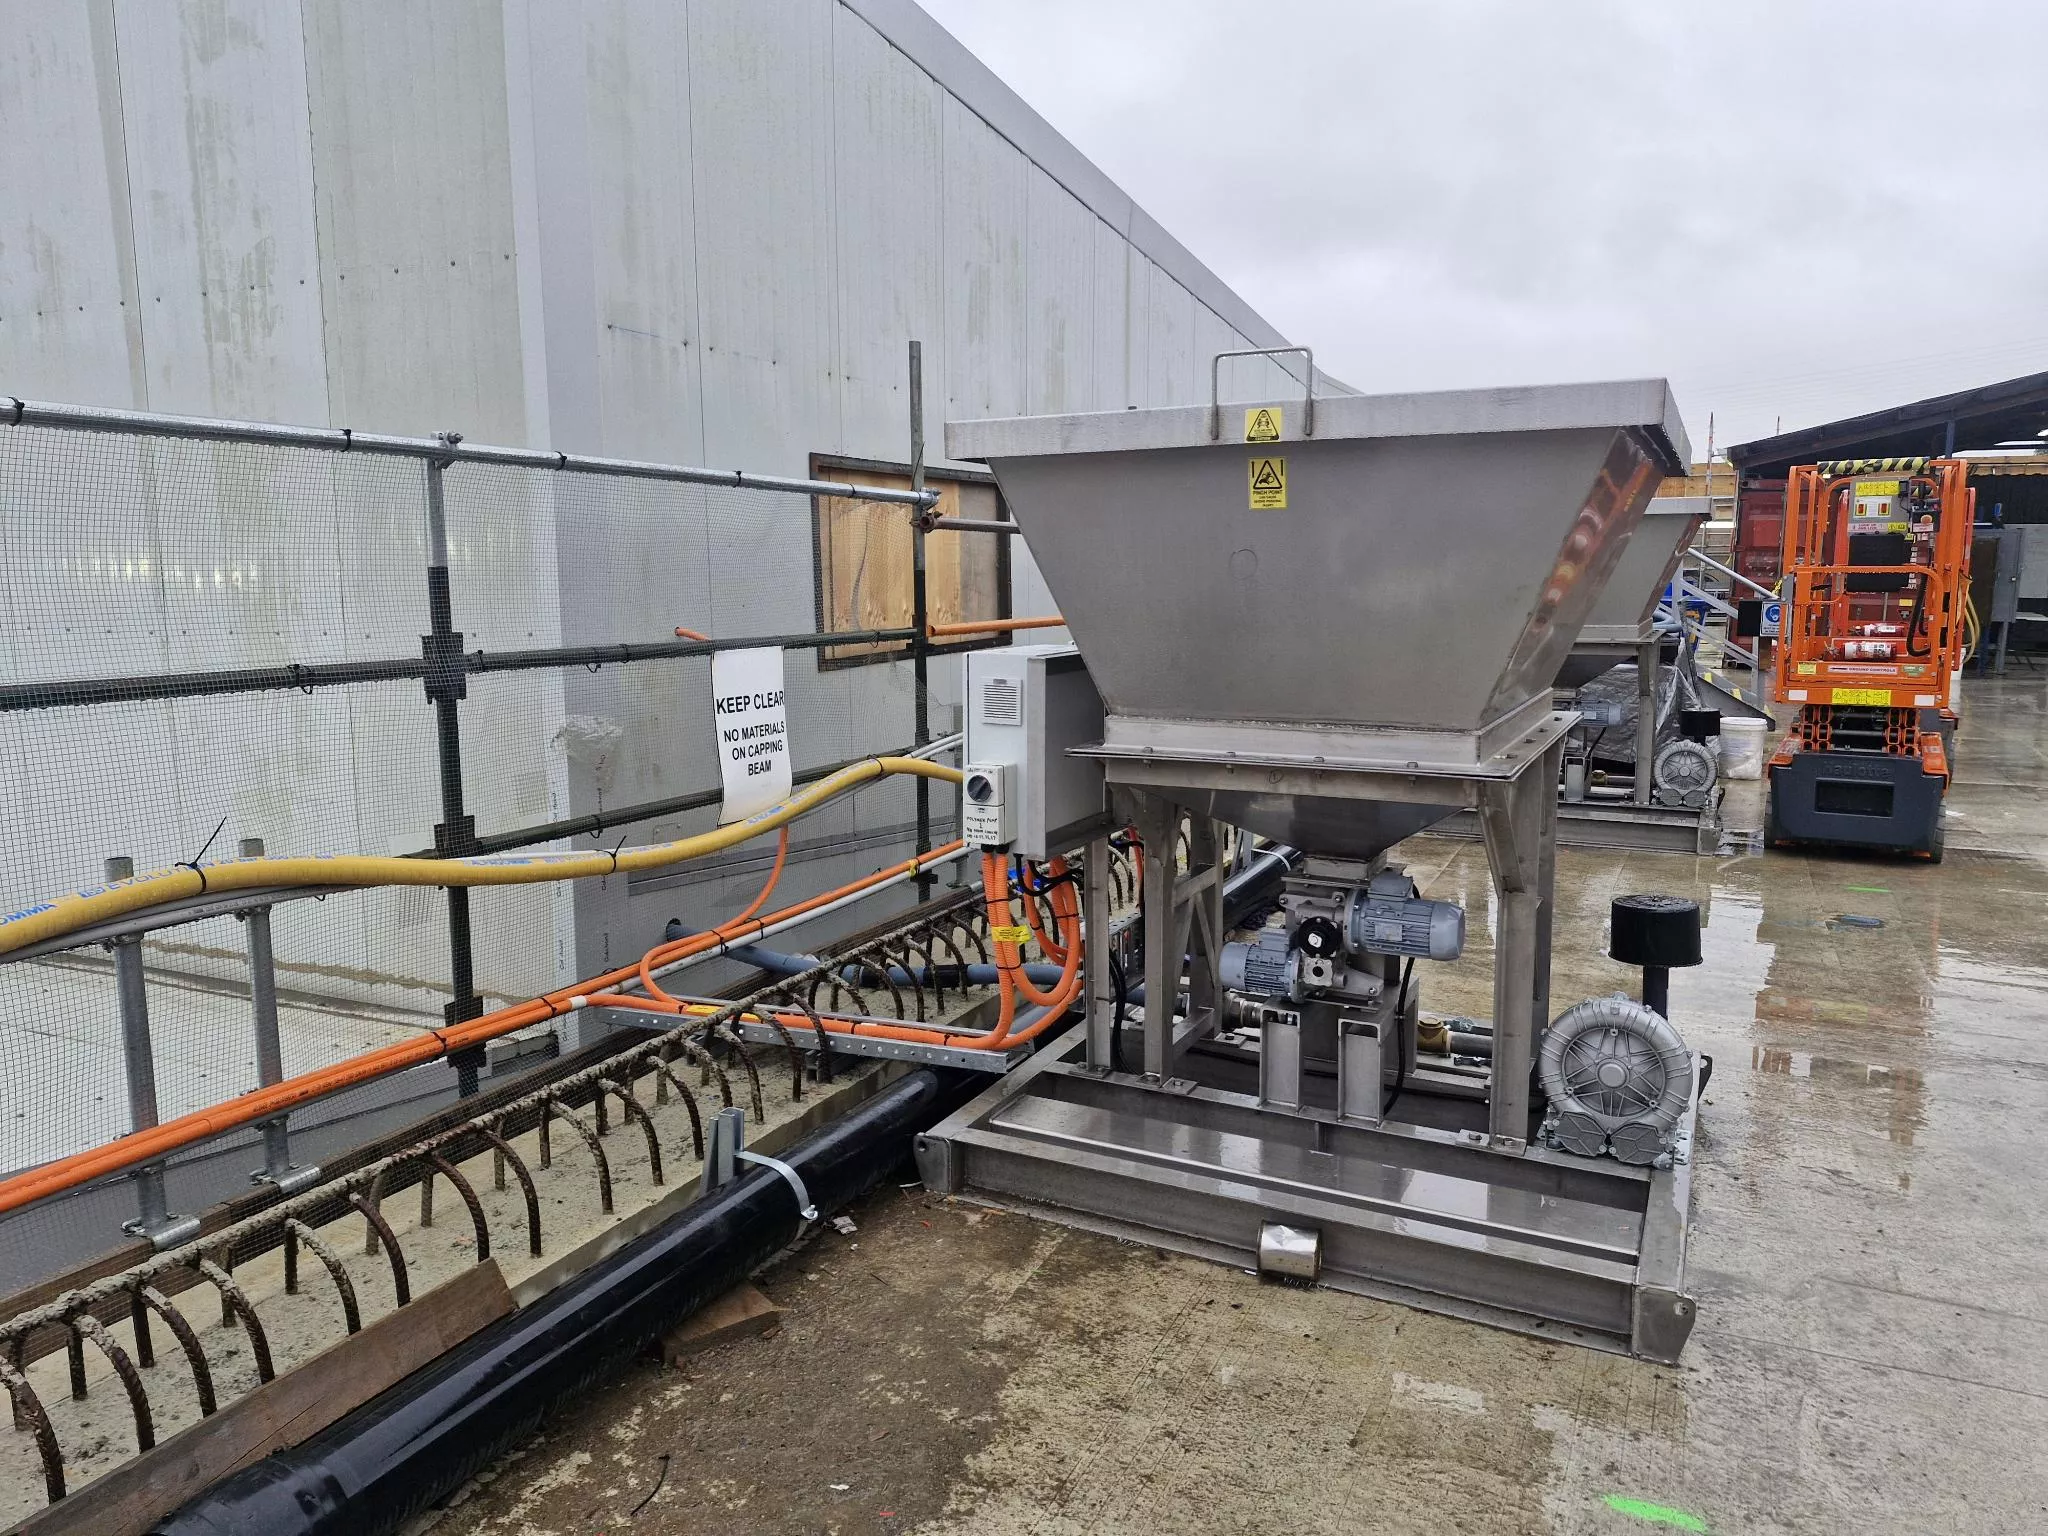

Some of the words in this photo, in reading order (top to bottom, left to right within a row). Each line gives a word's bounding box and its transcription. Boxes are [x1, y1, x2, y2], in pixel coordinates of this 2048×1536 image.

[716, 695, 750, 714] KEEP
[754, 690, 785, 709] CLEAR
[724, 729, 739, 743] NO
[742, 721, 785, 740] MATERIALS
[732, 747, 746, 760] ON
[748, 739, 783, 757] CAPPING
[748, 760, 772, 776] BEAM
